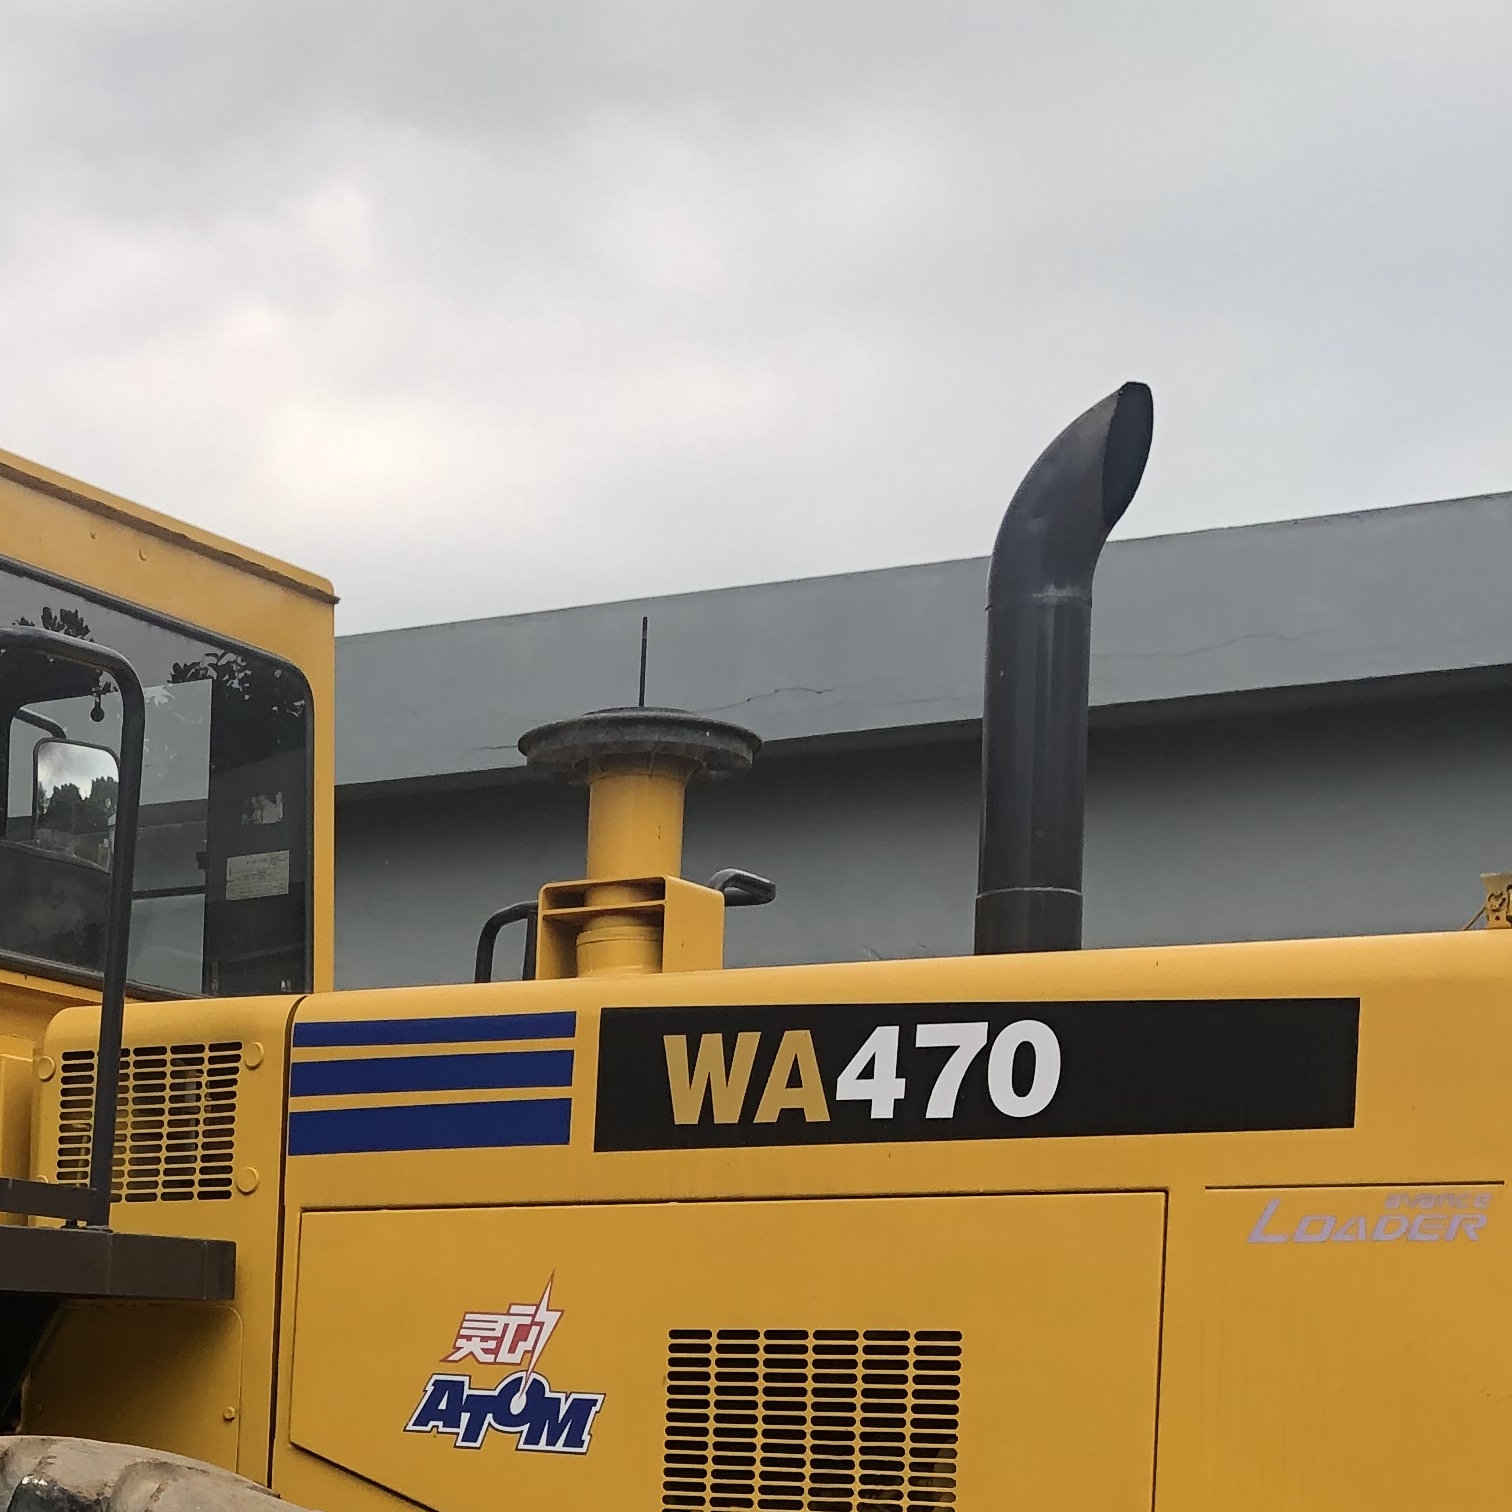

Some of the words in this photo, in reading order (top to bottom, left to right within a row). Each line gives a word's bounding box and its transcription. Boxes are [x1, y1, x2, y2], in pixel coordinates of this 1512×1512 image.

[663, 1019, 1062, 1126] WA470
[1247, 1197, 1487, 1244] LOADER
[403, 1370, 606, 1455] ATOM
